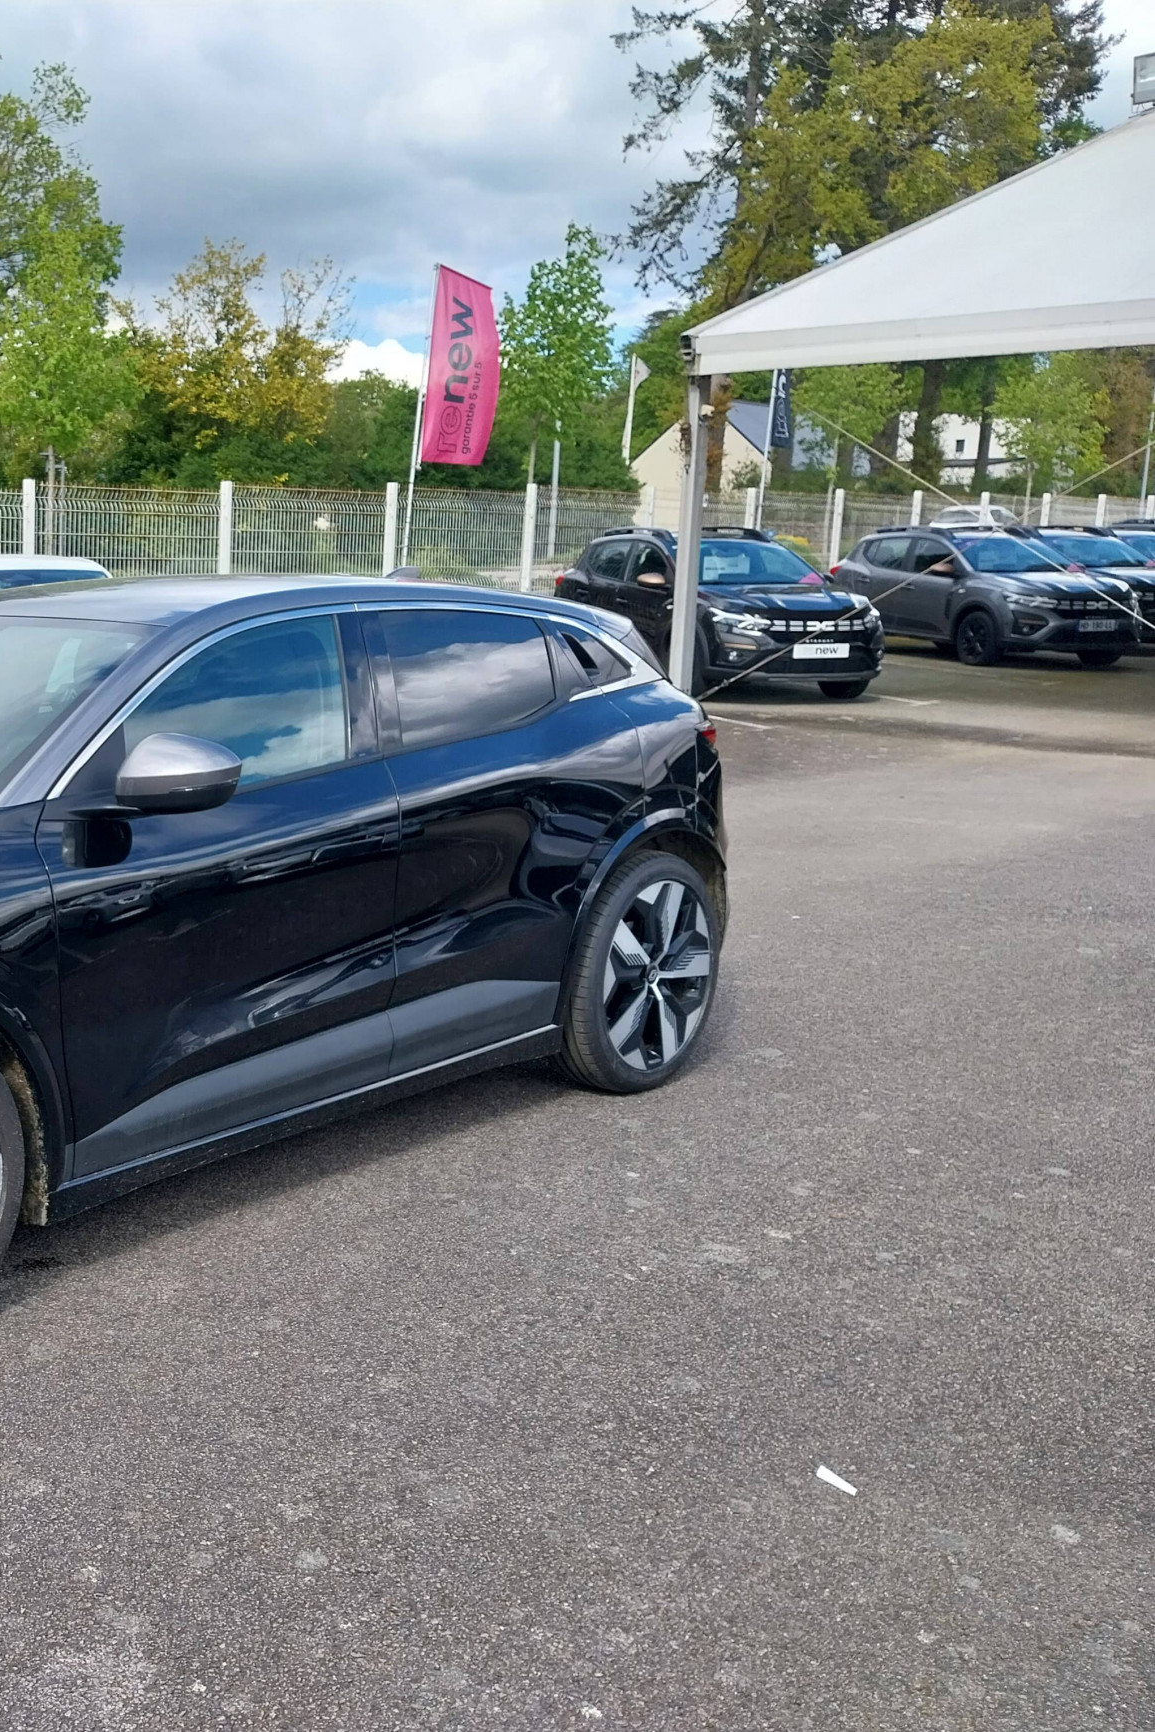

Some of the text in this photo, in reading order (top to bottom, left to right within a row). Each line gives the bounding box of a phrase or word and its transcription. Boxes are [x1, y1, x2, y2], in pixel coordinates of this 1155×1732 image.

[437, 296, 474, 453] renew
[472, 371, 482, 390] sur
[474, 361, 483, 369] 5
[461, 403, 477, 454] garantie
